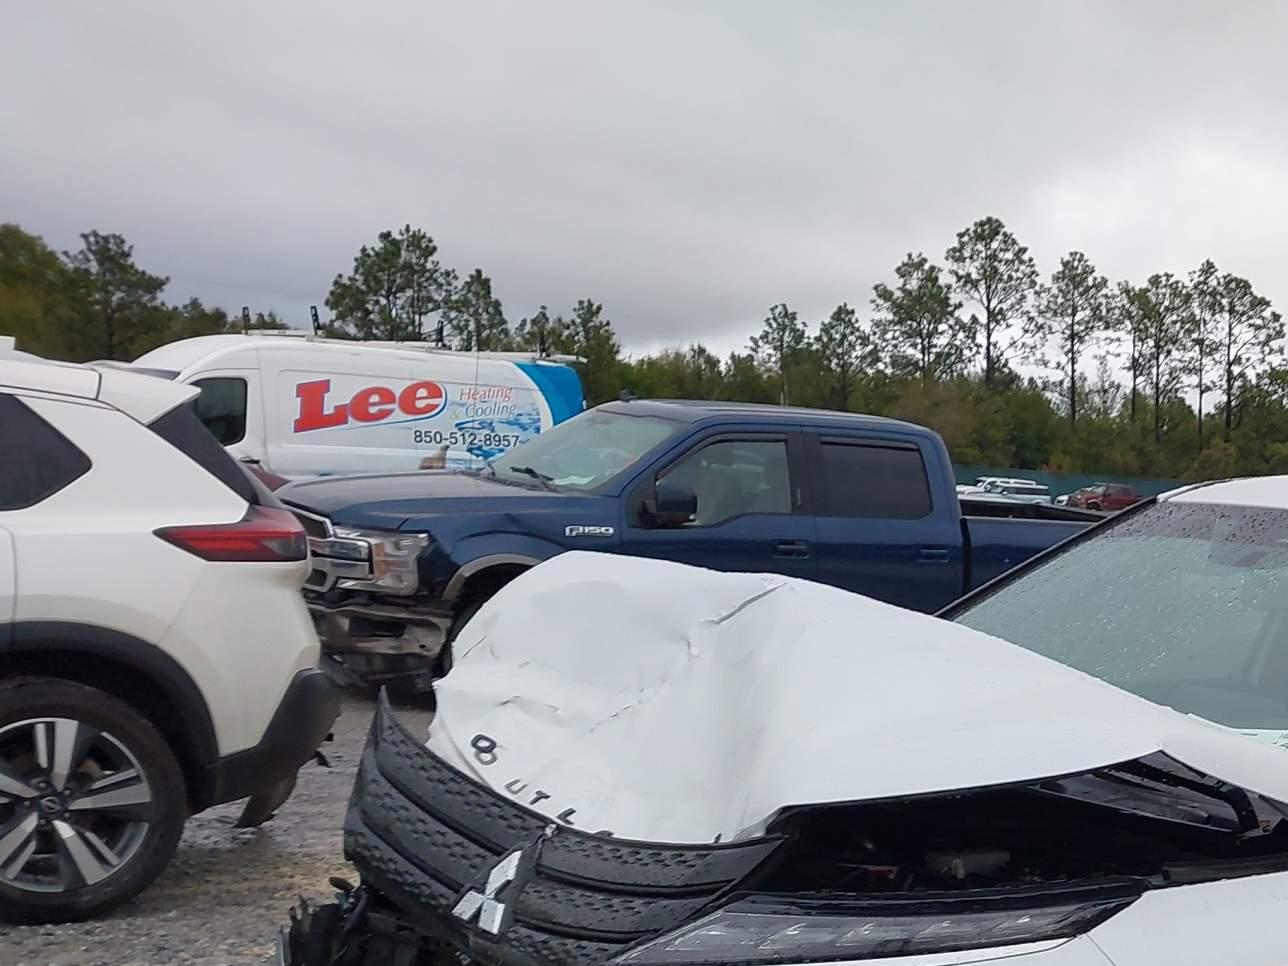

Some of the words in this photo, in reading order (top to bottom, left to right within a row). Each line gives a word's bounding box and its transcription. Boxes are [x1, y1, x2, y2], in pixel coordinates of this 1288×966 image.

[459, 385, 513, 402] Heating
[293, 379, 444, 433] Lee
[465, 402, 518, 418] Cooling
[413, 430, 521, 449] 850-512-8957
